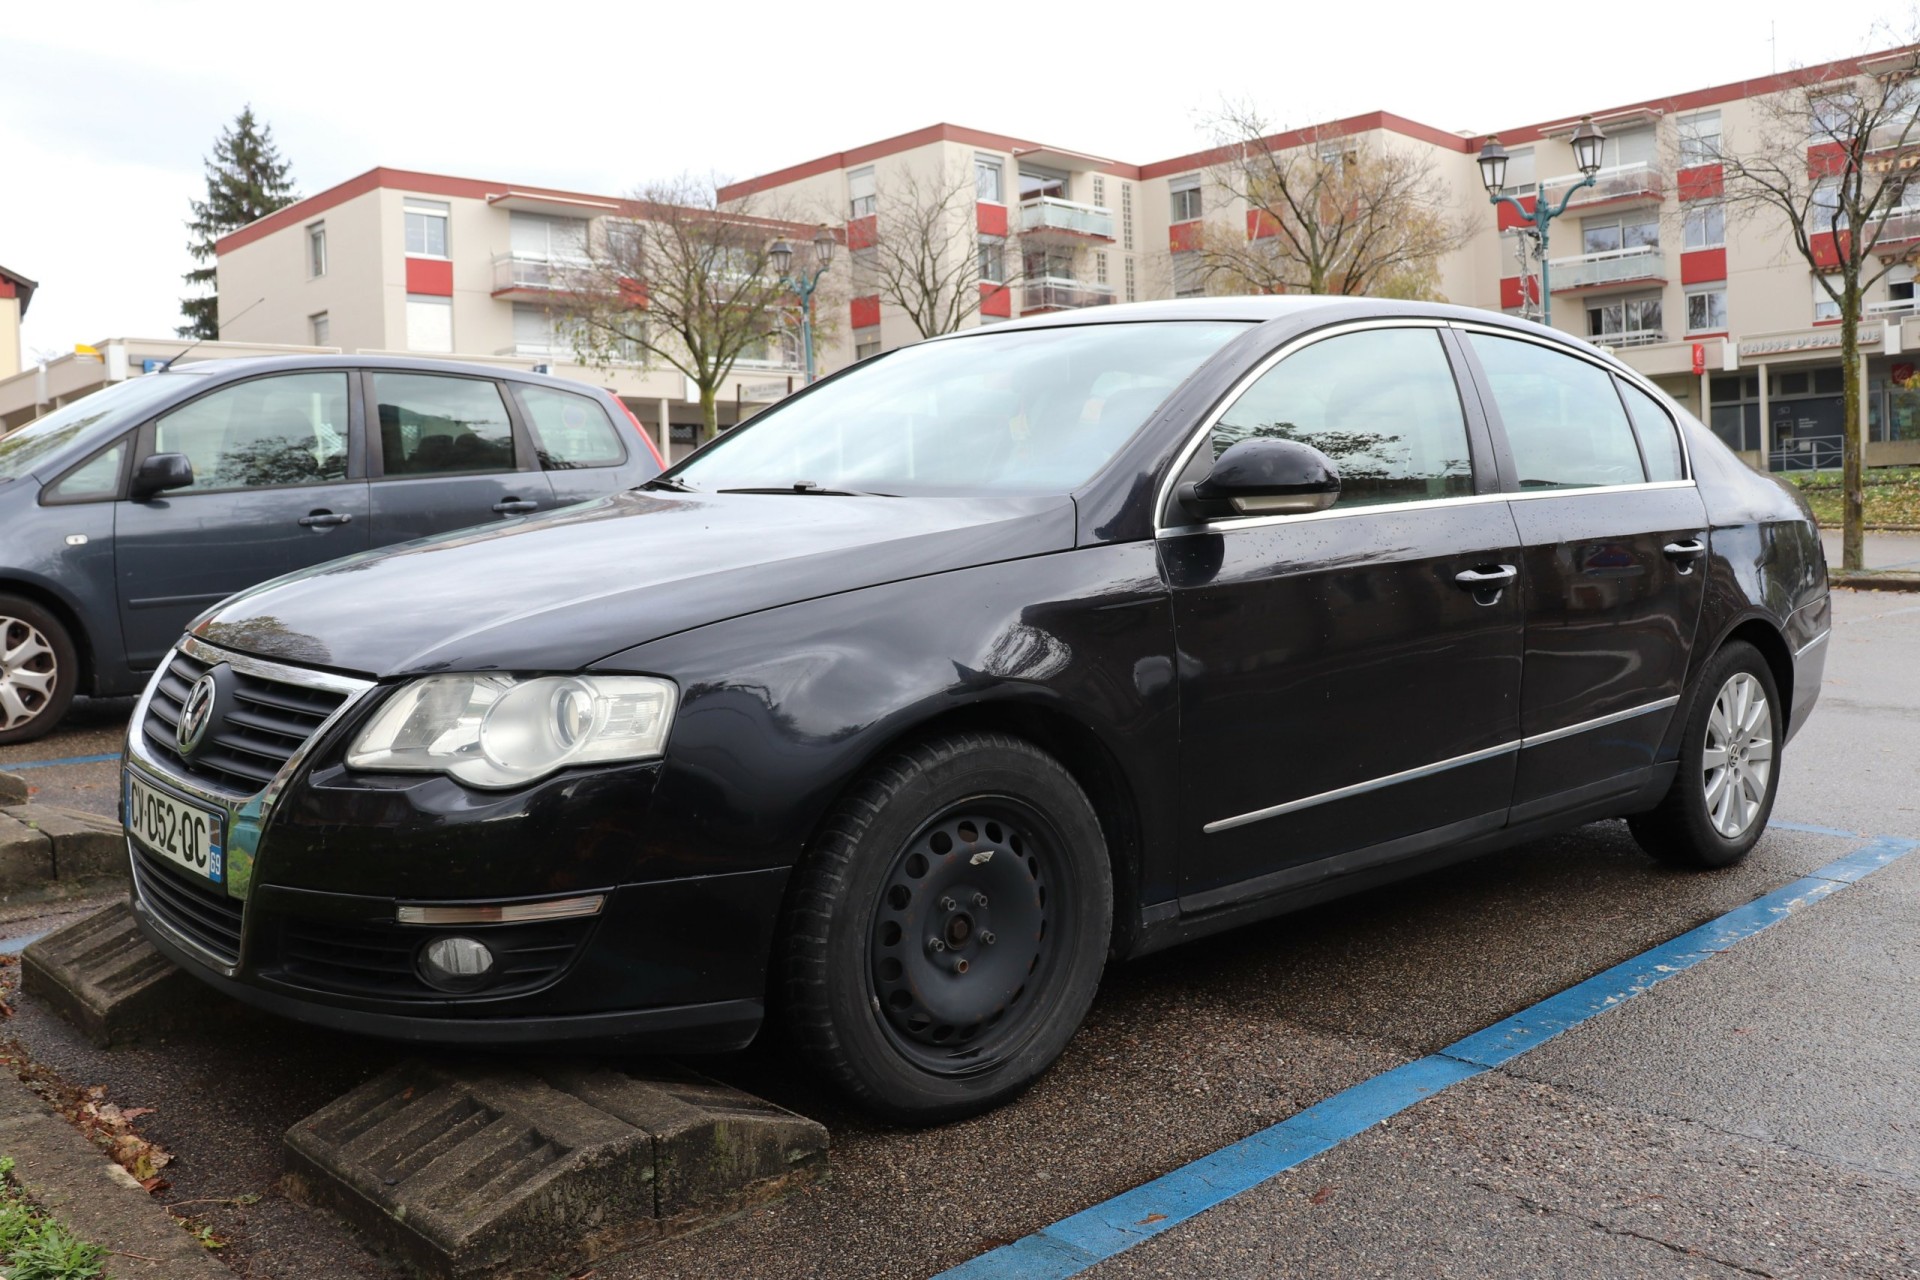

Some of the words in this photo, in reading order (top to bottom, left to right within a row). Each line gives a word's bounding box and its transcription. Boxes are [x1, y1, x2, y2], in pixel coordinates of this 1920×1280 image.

[1742, 339, 1790, 353] CAISSE
[1797, 330, 1880, 348] D'EPANE
[210, 851, 221, 875] 69
